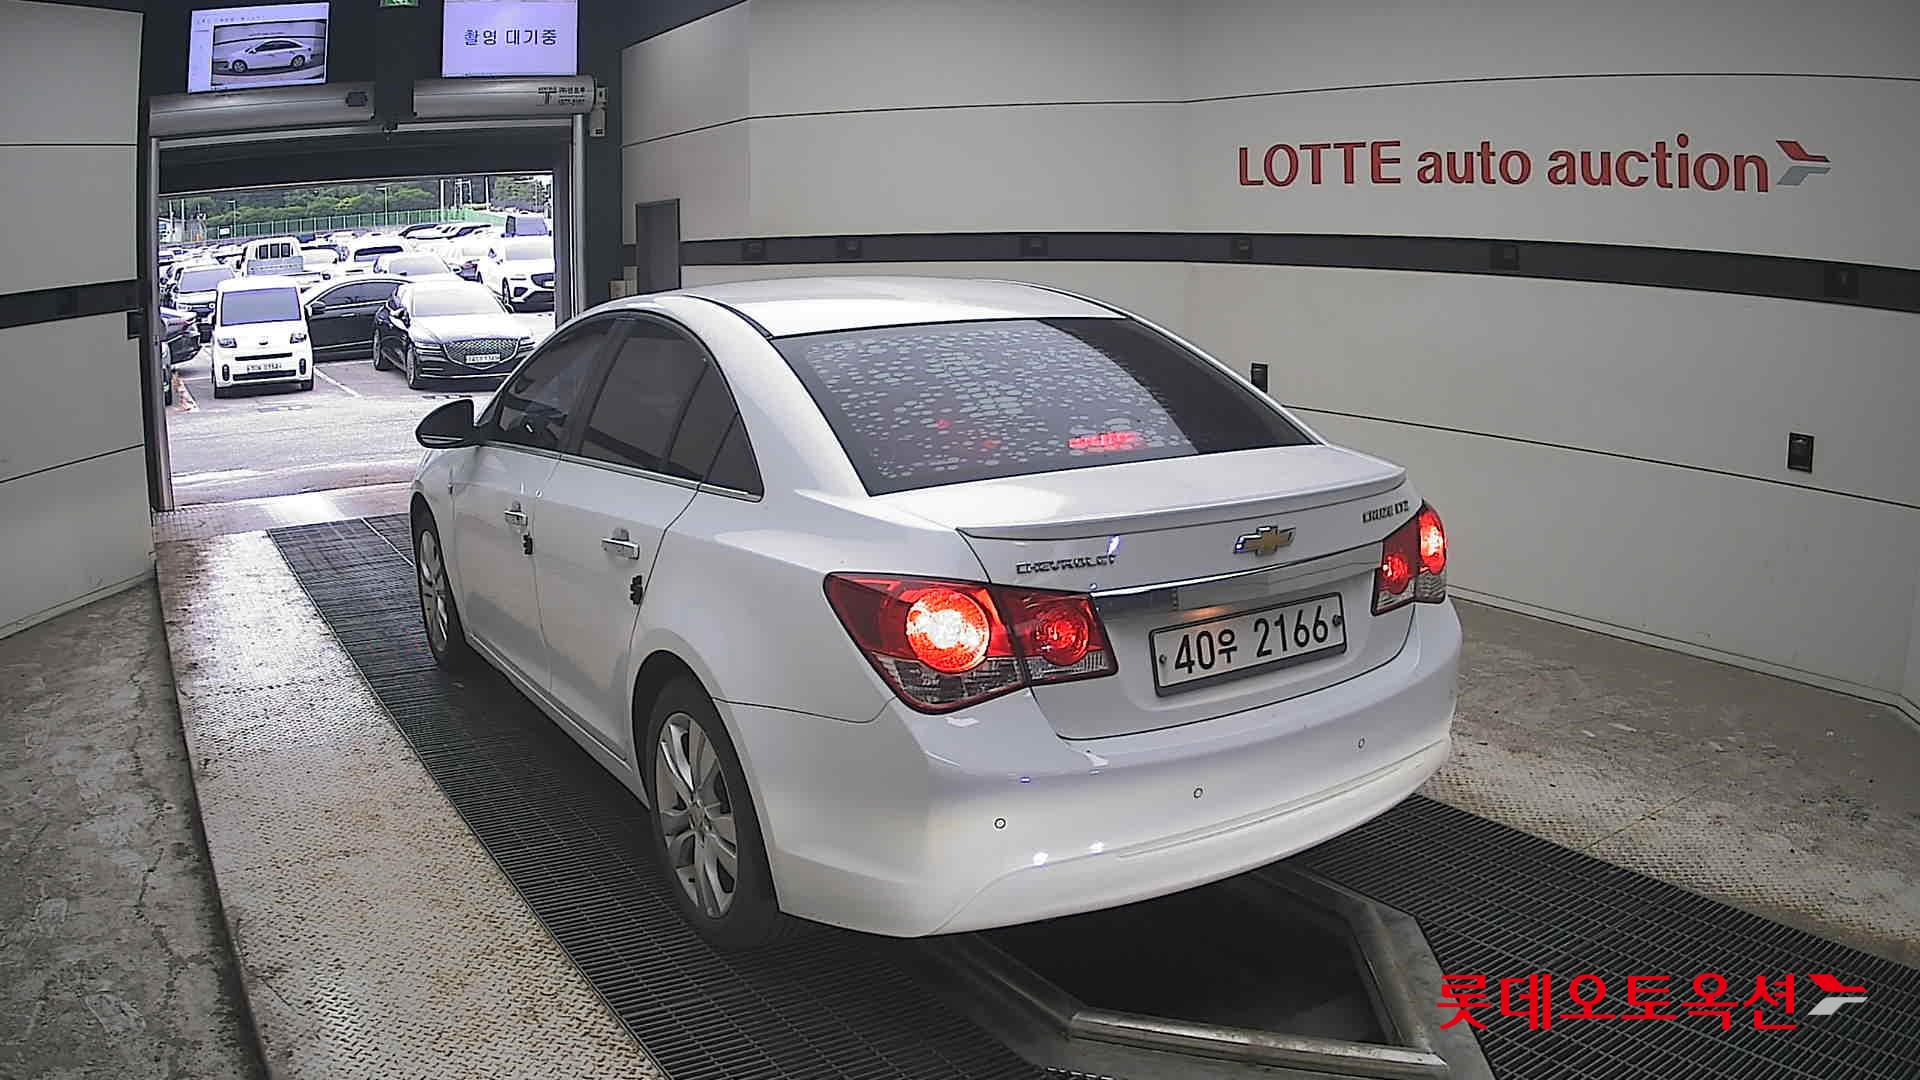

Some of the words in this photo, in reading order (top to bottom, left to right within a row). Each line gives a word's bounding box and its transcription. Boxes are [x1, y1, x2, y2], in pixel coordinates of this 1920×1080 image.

[505, 29, 557, 46] 대기중
[1239, 140, 1401, 187] LOTTE
[1416, 141, 1532, 186] auto
[1547, 134, 1769, 192] auction
[1016, 554, 1116, 575] CHEVROLET
[1174, 628, 1238, 674] 40우
[1253, 605, 1329, 658] 2166
